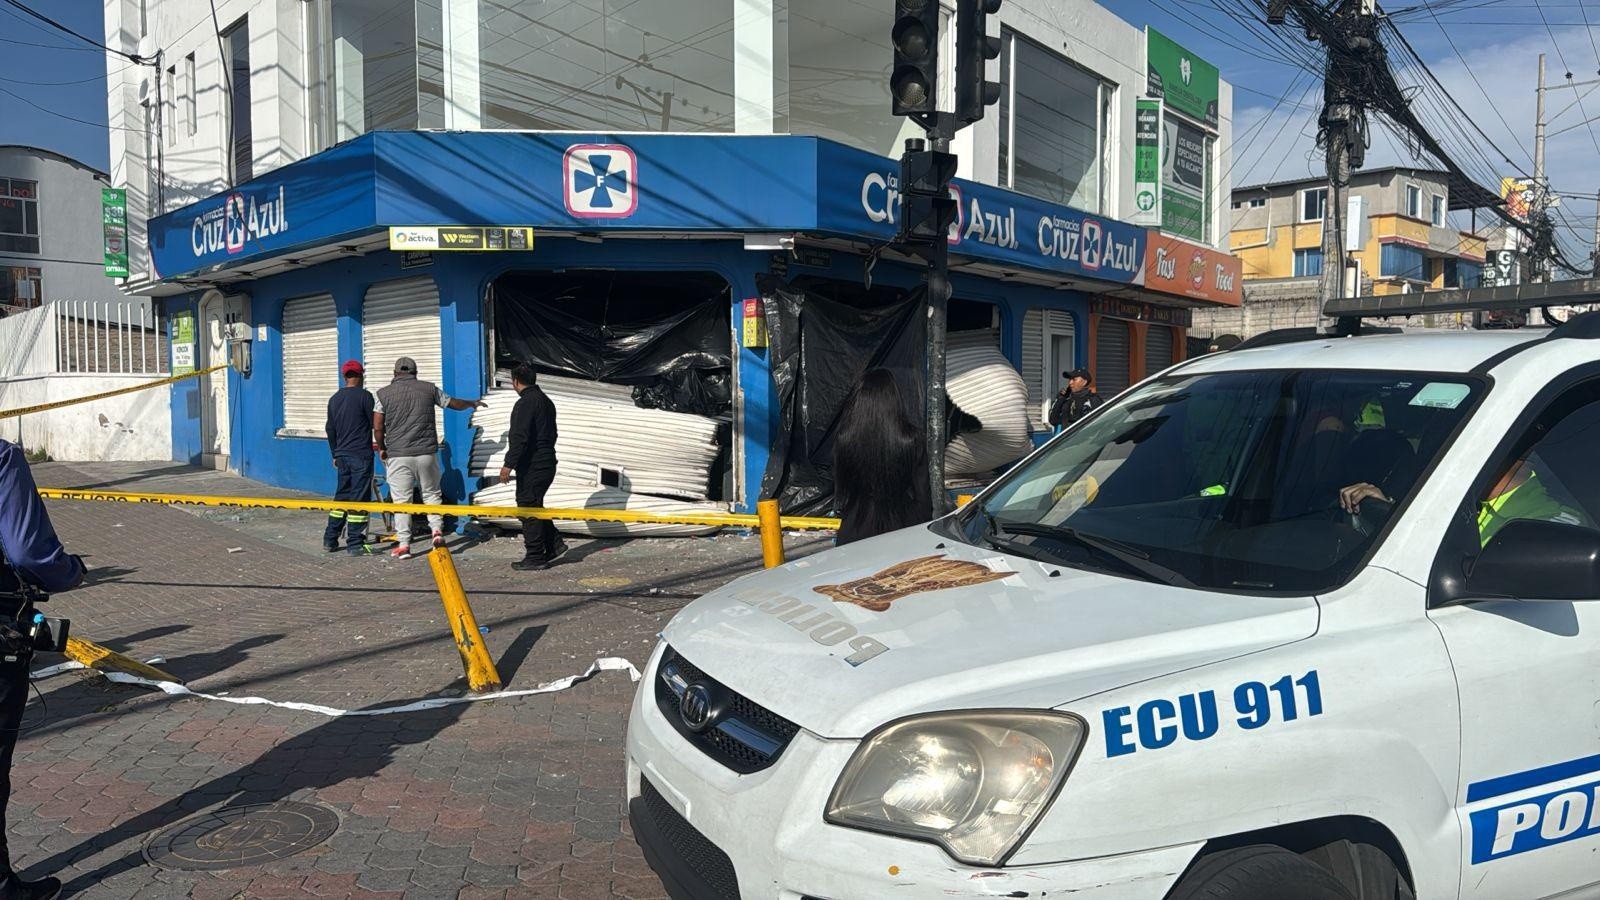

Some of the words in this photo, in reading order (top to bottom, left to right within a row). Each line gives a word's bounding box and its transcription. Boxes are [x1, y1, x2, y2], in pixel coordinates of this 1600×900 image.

[861, 172, 902, 224] Cr
[192, 217, 225, 257] Cruz
[1038, 216, 1080, 260] Cruz
[1053, 215, 1080, 231] farmacias
[1156, 247, 1176, 280] Fast
[1216, 264, 1234, 293] Food
[1101, 689, 1219, 759] ECU
[1233, 669, 1324, 730] 911
